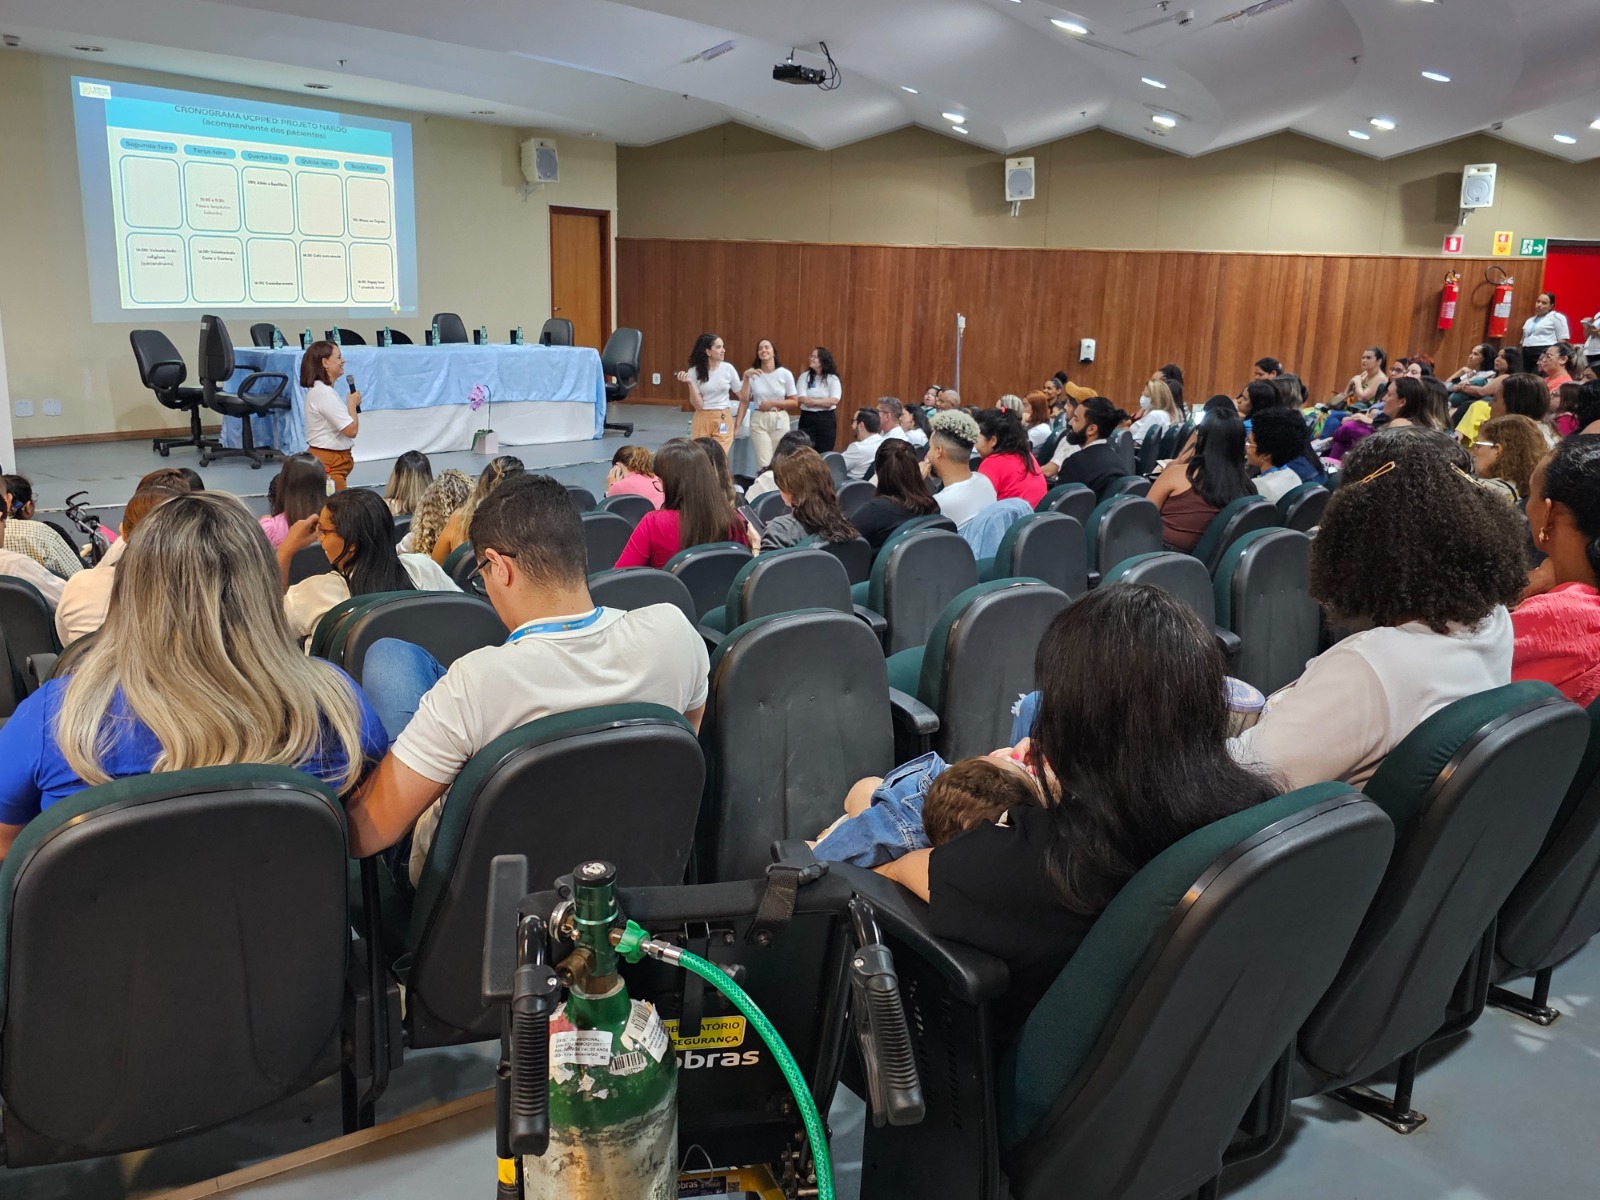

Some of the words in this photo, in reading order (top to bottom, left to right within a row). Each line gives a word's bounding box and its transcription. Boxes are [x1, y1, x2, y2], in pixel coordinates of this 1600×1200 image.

[174, 105, 241, 120] CRONOGRAMA
[281, 118, 318, 130] PROJETO
[319, 124, 348, 134] NARDO
[270, 127, 285, 135] dos
[672, 1036, 739, 1046] SEGURANÇA
